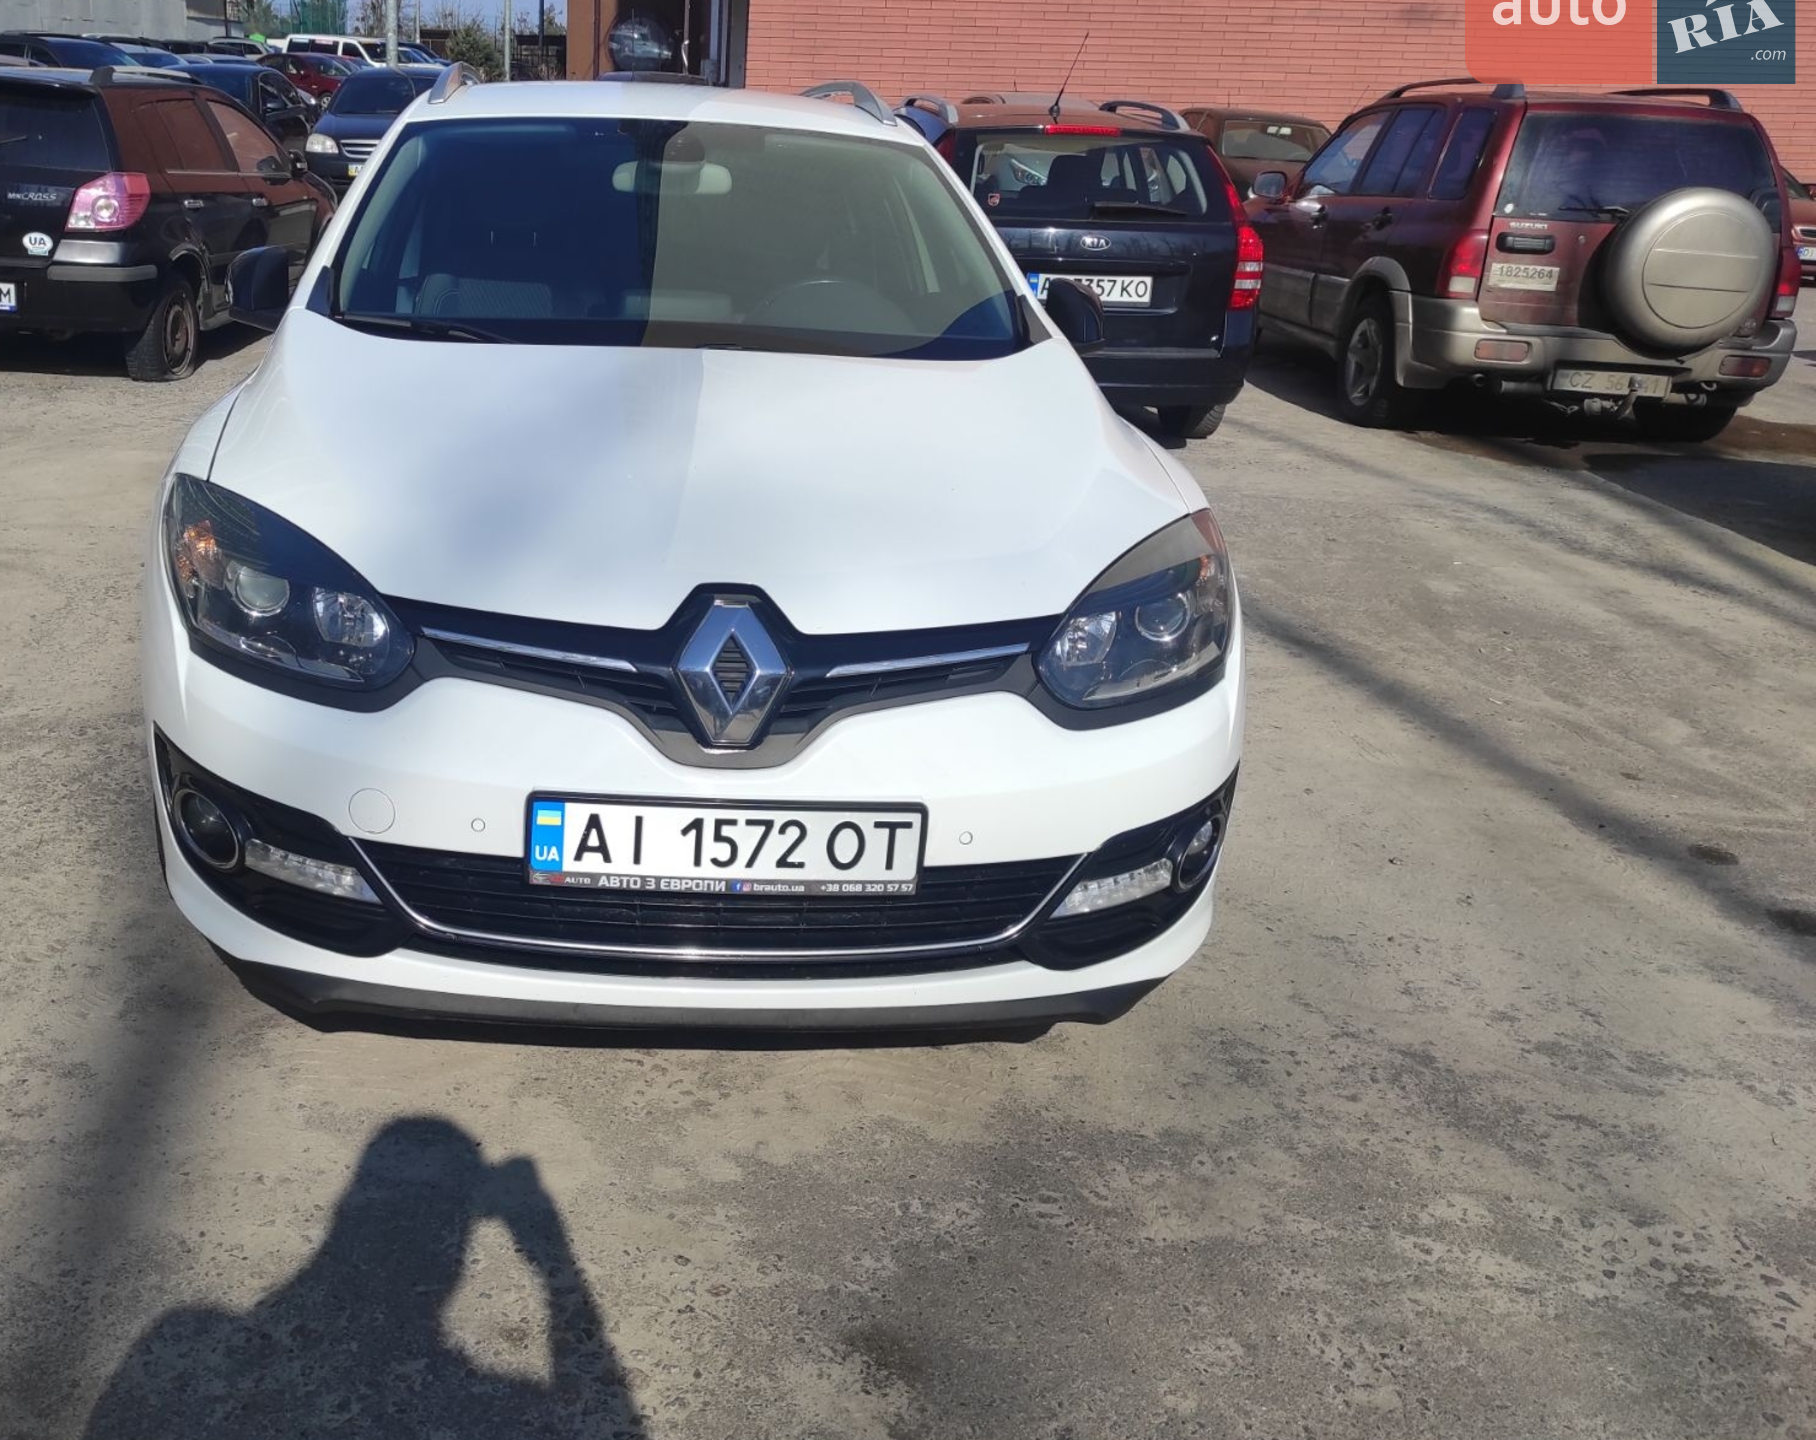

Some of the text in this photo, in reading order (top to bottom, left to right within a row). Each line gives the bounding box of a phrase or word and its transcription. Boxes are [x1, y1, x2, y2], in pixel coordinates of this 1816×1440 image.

[28, 236, 47, 247] UA
[1083, 237, 1108, 248] KIA
[1500, 265, 1554, 279] 1825264
[1120, 279, 1148, 298] KO
[1569, 371, 1596, 389] CZ
[573, 813, 914, 871] AI 1572 OT
[535, 845, 560, 861] UA
[597, 875, 642, 889] АВТО
[753, 883, 805, 892] brauto.ua
[841, 883, 863, 892] 068
[864, 884, 884, 892] 320
[886, 884, 899, 892] 57
[901, 884, 914, 892] 57
